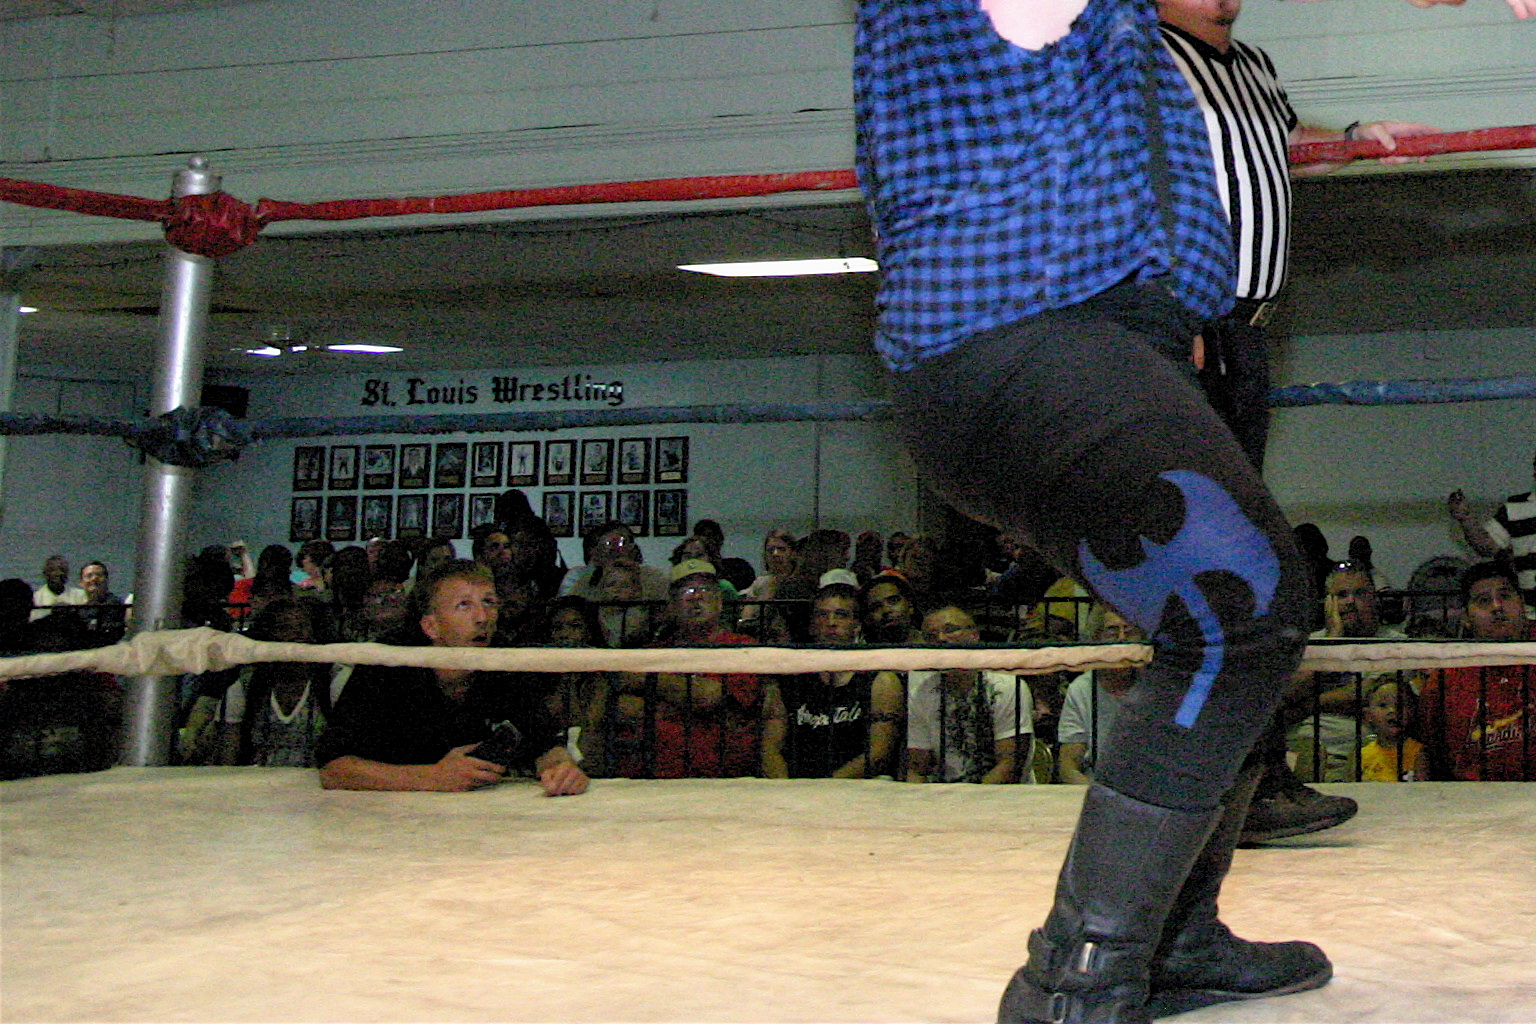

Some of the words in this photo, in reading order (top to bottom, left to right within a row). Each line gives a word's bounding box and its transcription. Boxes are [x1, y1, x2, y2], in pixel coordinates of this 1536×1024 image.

[361, 378, 396, 406] St.
[406, 378, 478, 405] Louis
[492, 374, 624, 406] Wrestling
